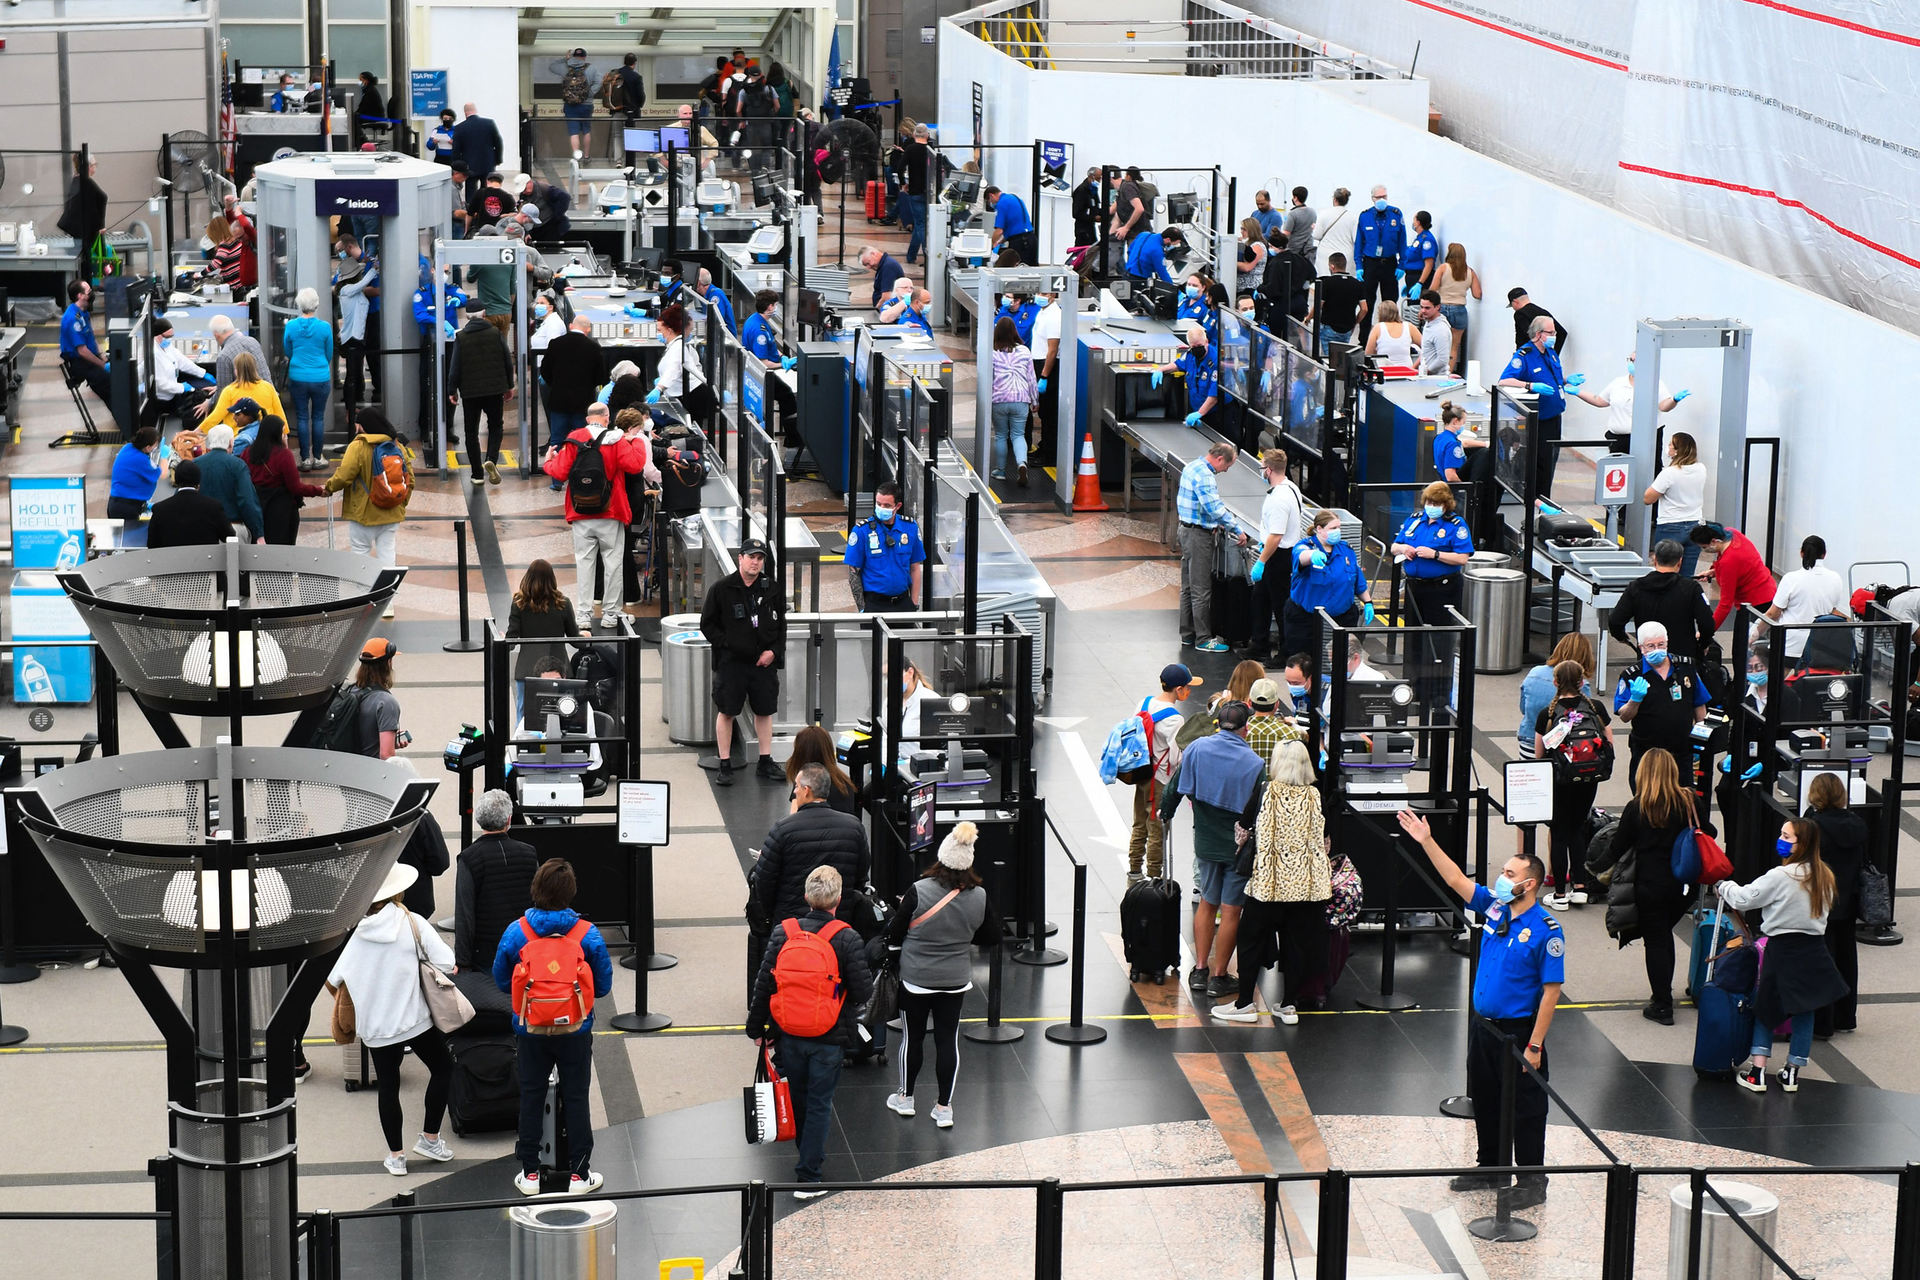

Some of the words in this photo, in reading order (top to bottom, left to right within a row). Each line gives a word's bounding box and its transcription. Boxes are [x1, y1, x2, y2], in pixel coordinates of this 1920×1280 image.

[348, 199, 379, 208] leidos
[501, 248, 514, 263] 6
[1052, 276, 1065, 292] 4
[1726, 330, 1734, 346] 1
[18, 491, 61, 502] EMPTY
[65, 491, 76, 502] IT
[19, 504, 59, 515] HOLD
[64, 504, 76, 514] IT
[19, 517, 62, 527] REFILL
[66, 517, 76, 526] IT
